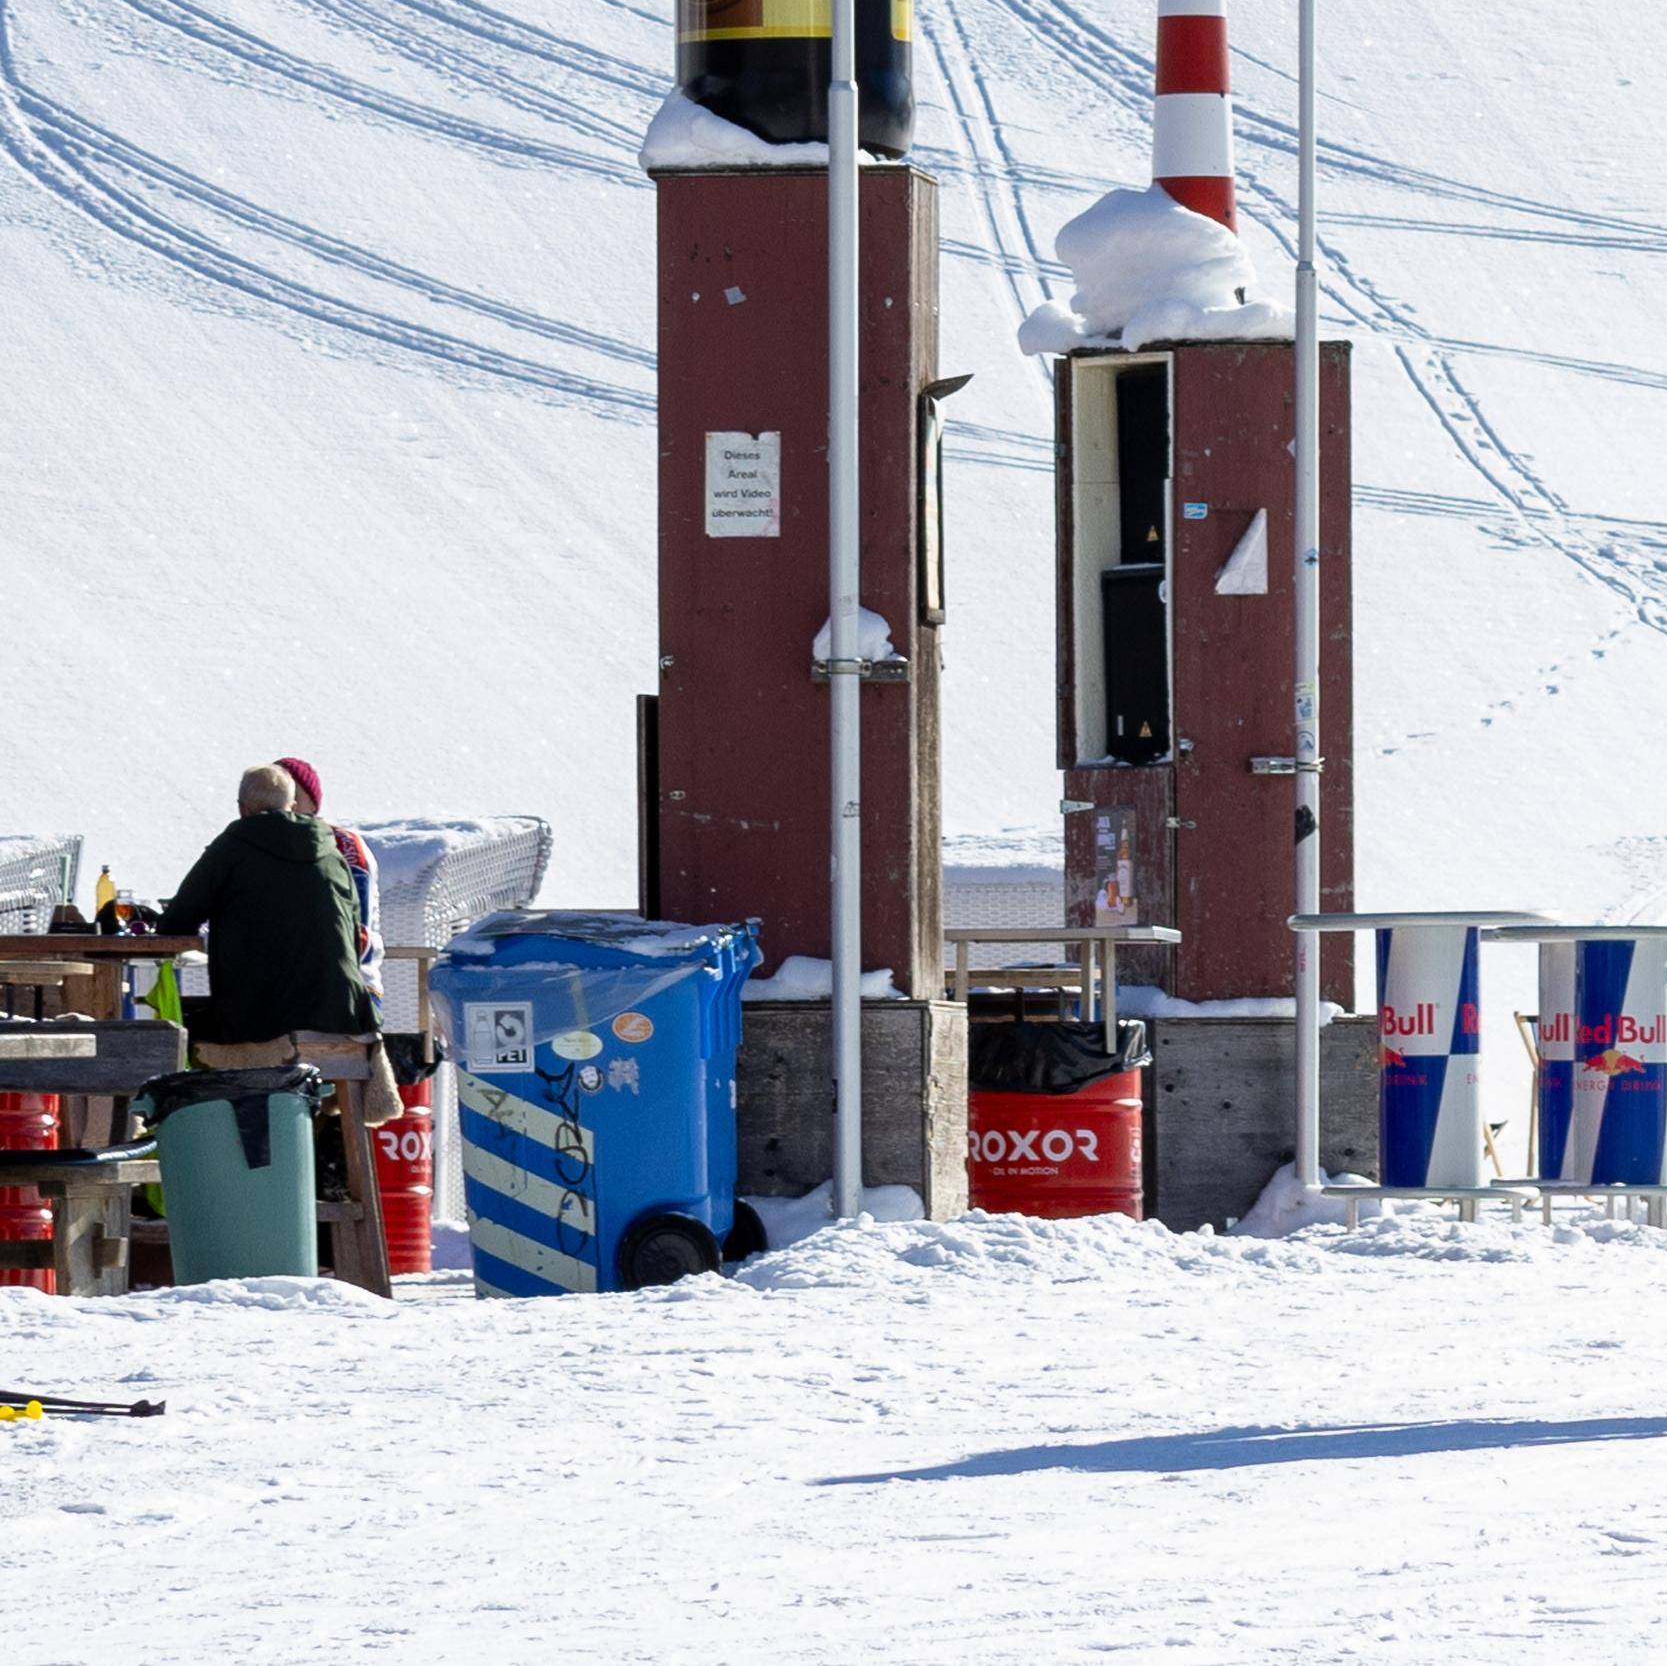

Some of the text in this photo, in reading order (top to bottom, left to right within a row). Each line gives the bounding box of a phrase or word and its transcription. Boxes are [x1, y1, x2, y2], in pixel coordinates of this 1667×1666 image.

[724, 450, 760, 460] Dieses
[728, 470, 757, 479] Areal
[714, 489, 772, 498] wird Video
[712, 508, 773, 518] überwacht!
[1382, 1003, 1434, 1036] Bull
[1538, 1013, 1569, 1042] ull
[1618, 1015, 1666, 1044] Bull
[1576, 1080, 1616, 1091] NERGY
[378, 1131, 433, 1161] ROX
[968, 1129, 1099, 1162] ROXOR
